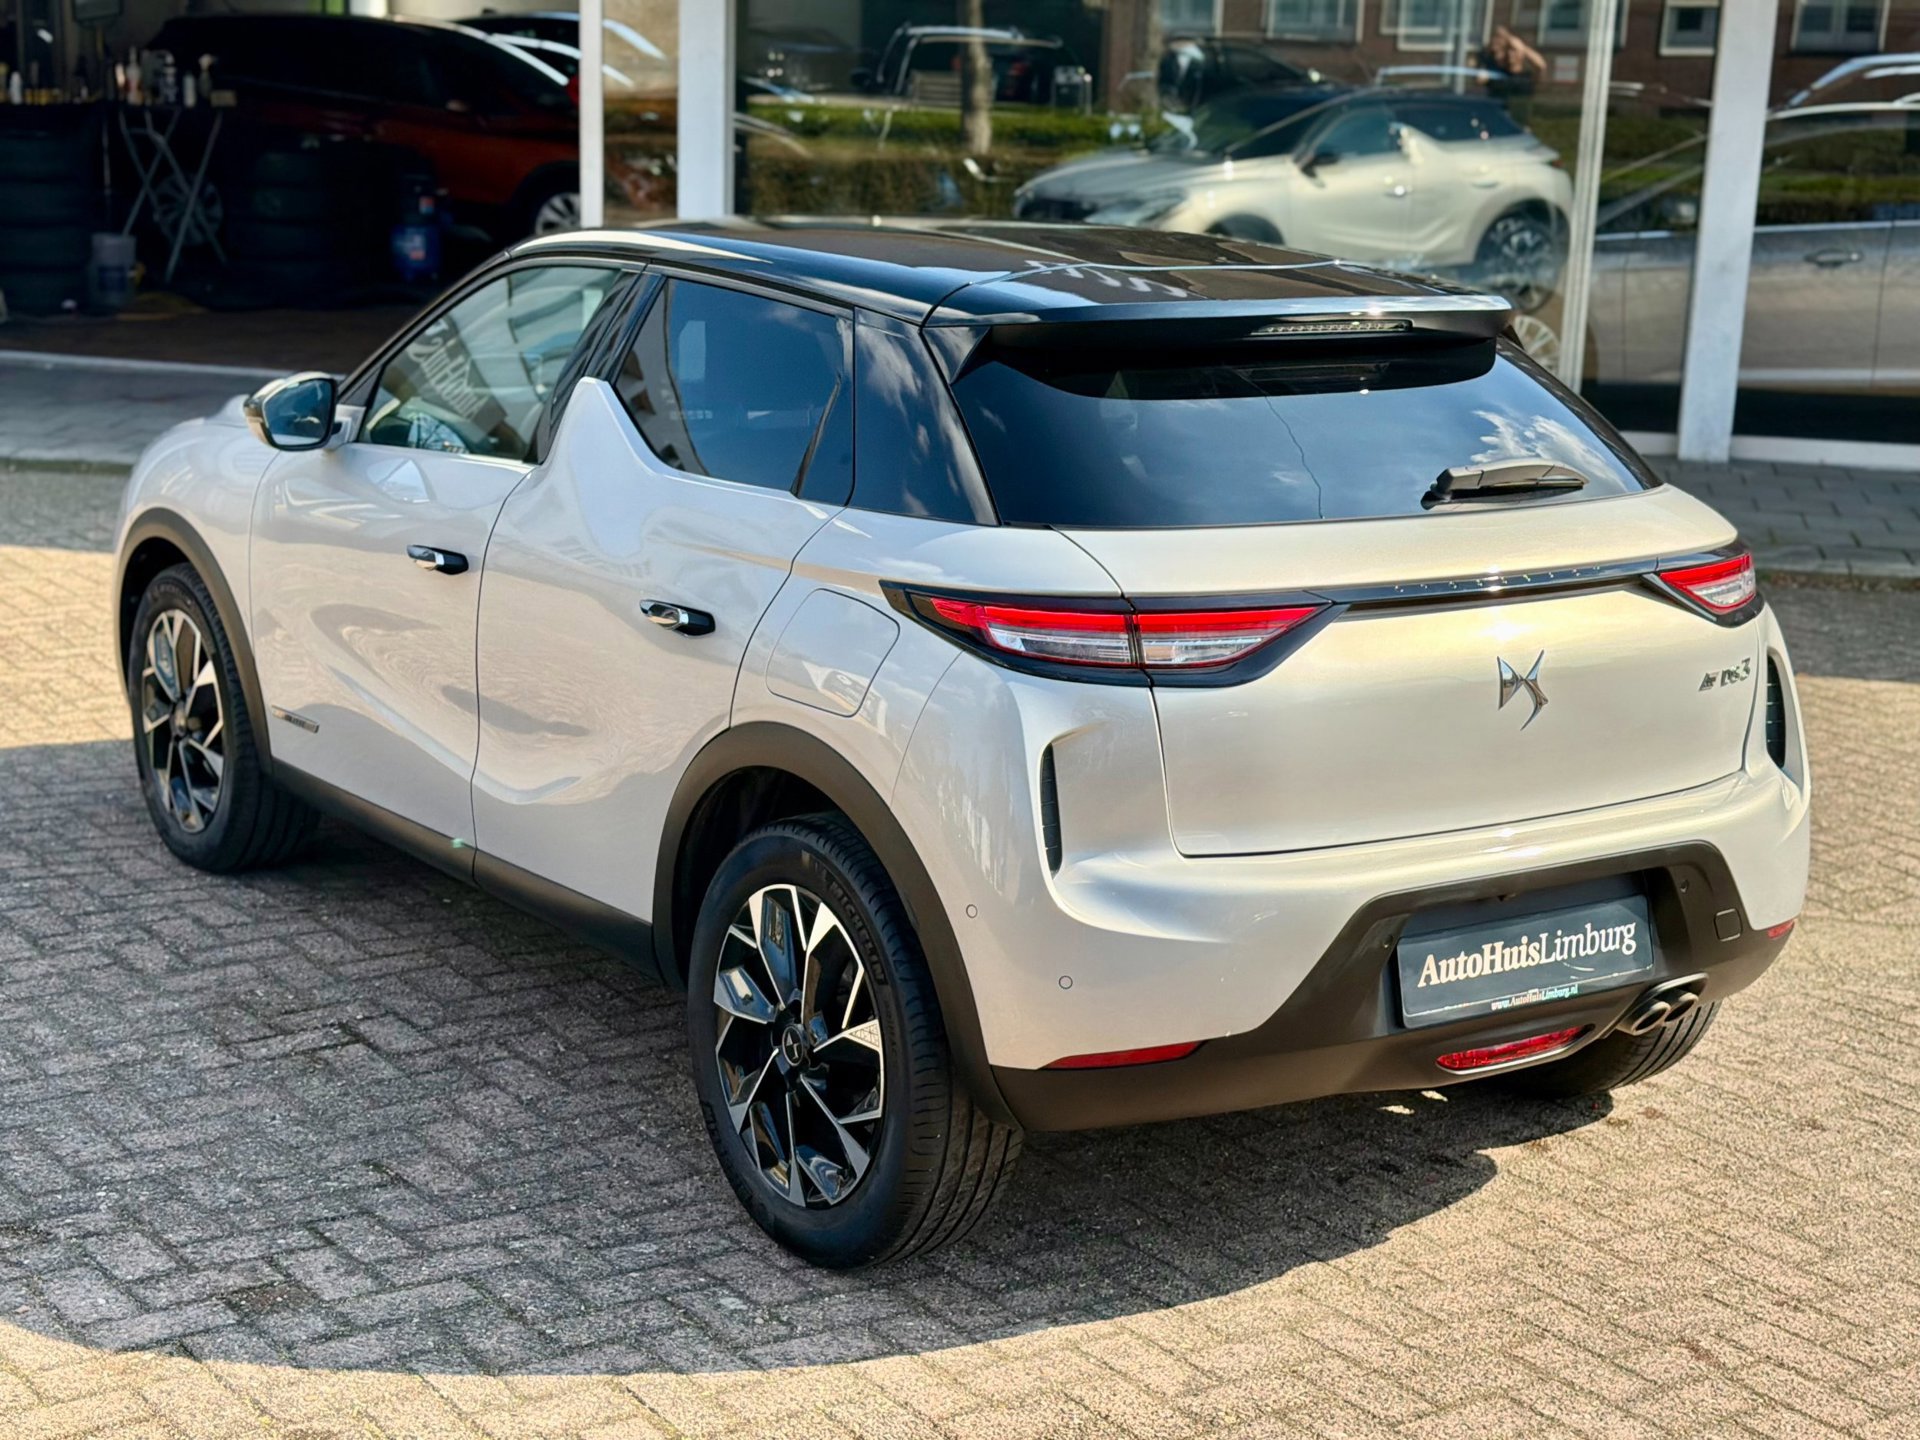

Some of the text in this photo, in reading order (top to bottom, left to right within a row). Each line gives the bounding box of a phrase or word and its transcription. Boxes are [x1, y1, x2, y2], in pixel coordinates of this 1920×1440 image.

[828, 880, 889, 987] MICHELIN
[1417, 922, 1637, 988] AutoHuisLimburg
[1490, 984, 1579, 1011] www.AutoHuisLimburg.nl
